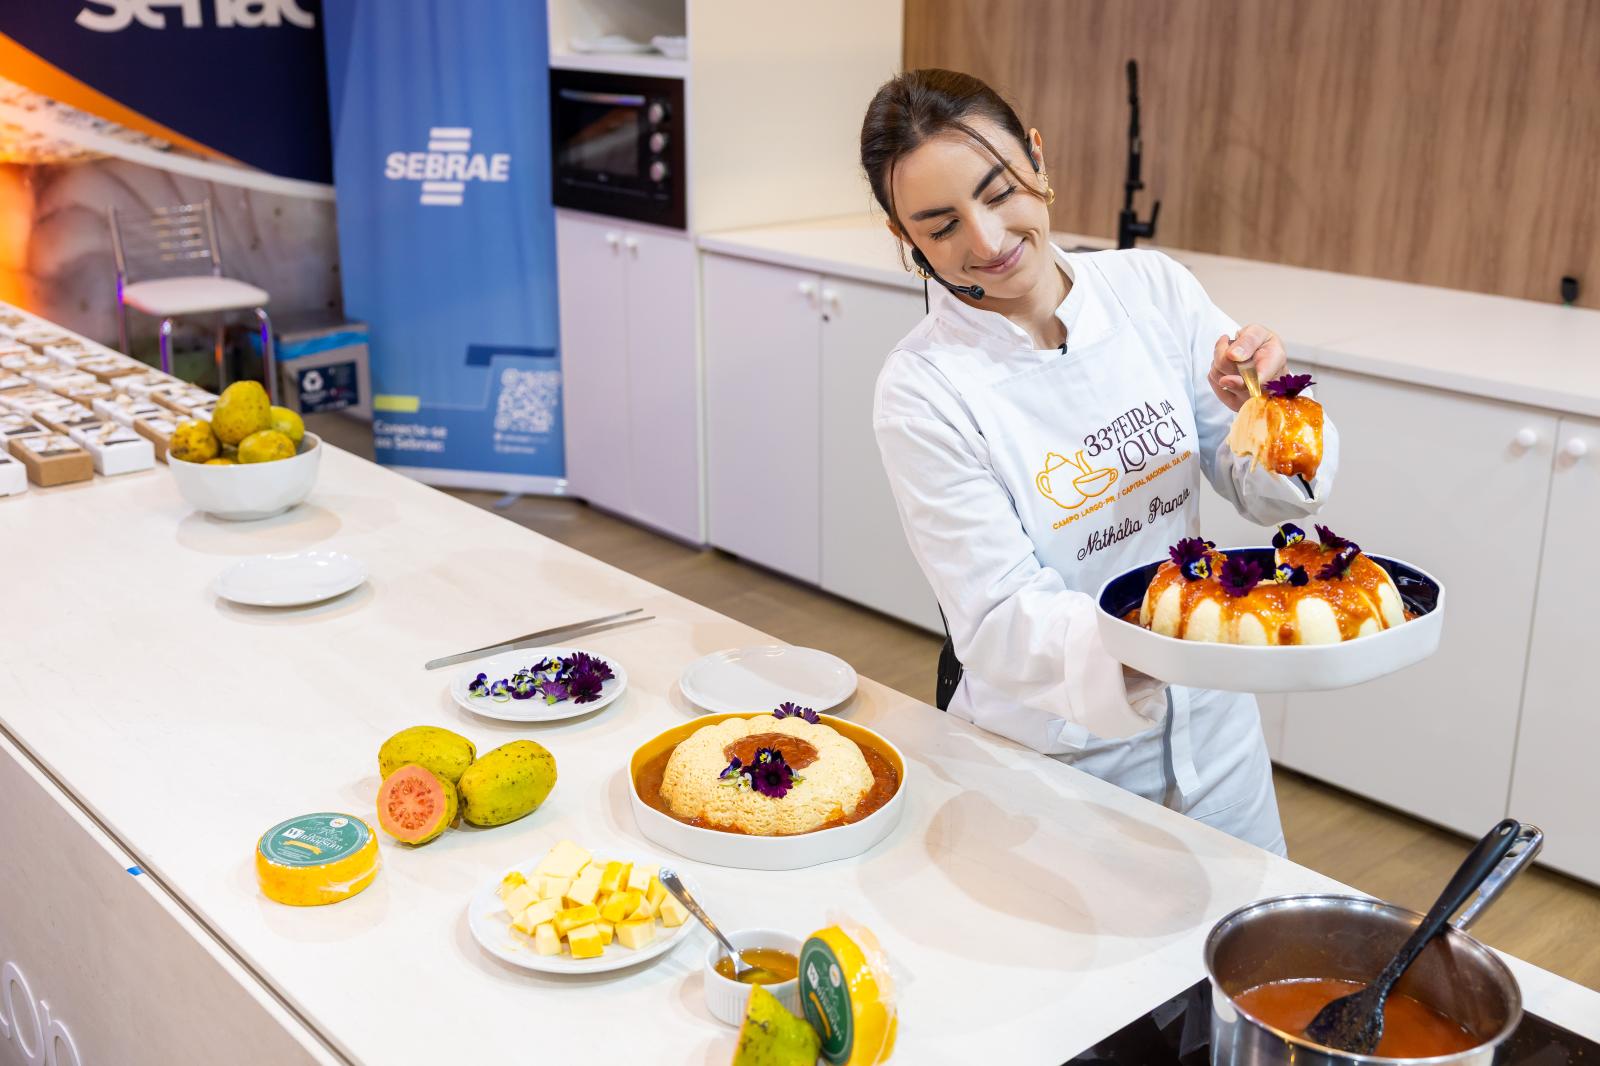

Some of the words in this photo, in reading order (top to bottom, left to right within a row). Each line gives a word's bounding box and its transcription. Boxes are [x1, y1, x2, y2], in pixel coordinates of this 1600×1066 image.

[384, 152, 511, 182] SEBRAE
[1111, 401, 1163, 444] FEIRA
[1159, 399, 1175, 416] DA
[1116, 416, 1187, 475] LOUÇA
[1052, 513, 1080, 530] CAMPO
[1121, 479, 1146, 496] CAPITAL
[1145, 463, 1172, 482] NACIONAL
[1076, 517, 1143, 561] Nathália
